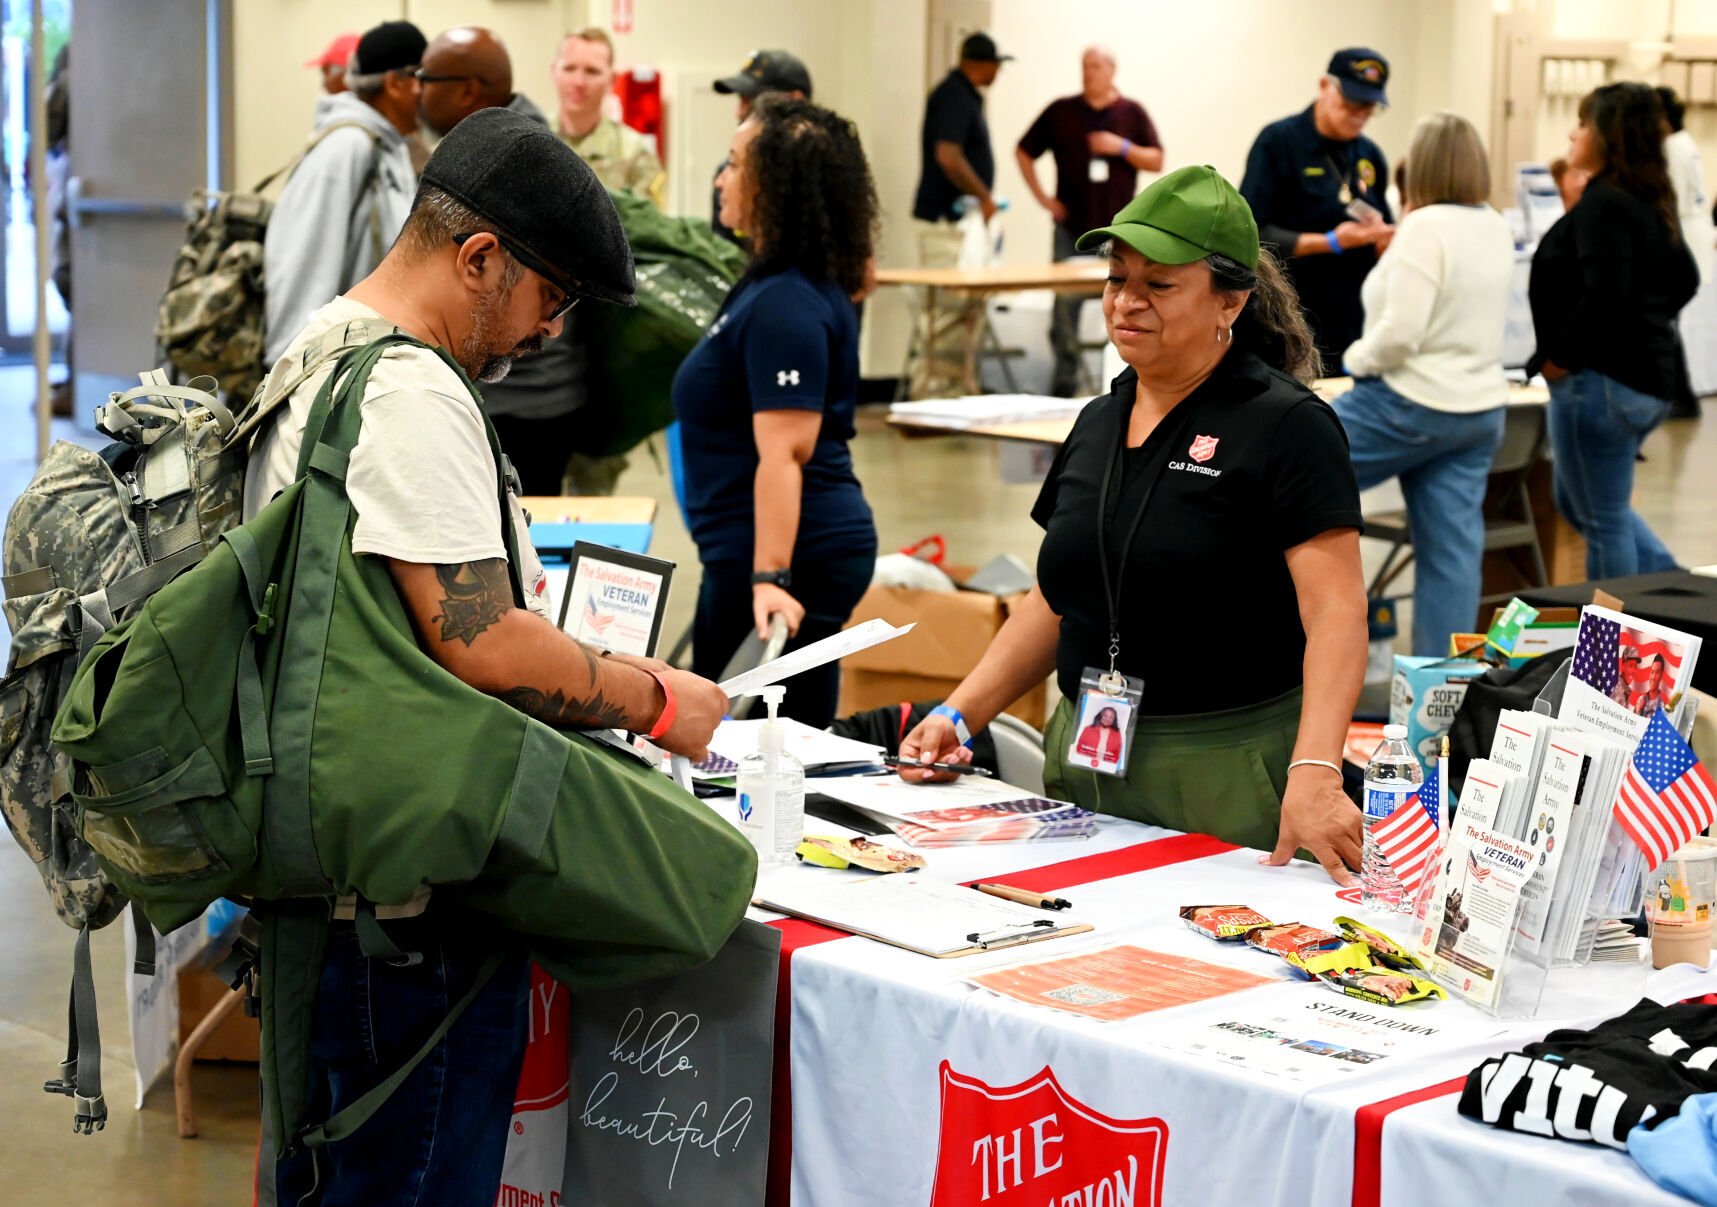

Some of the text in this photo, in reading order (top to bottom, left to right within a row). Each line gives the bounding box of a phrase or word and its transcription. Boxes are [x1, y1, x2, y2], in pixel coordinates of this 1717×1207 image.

[1168, 460, 1222, 477] CAS DIVISION
[581, 562, 657, 595] The Salvation Army
[603, 584, 649, 607] VETERAN
[1432, 690, 1462, 705] SOFT
[1591, 701, 1637, 727] The Salvation Army
[1504, 736, 1518, 751] The
[1492, 751, 1522, 773] Salvation
[1553, 756, 1566, 772] The
[1542, 773, 1569, 794] Salvation
[1472, 788, 1485, 803] The
[1542, 793, 1560, 813] Army
[1459, 803, 1488, 824] Salvation
[1466, 825, 1535, 864] The Salvation Army
[1483, 846, 1527, 870] VETERAN
[1305, 1002, 1376, 1021] STAND
[1373, 1018, 1440, 1036] DOWN
[609, 1007, 700, 1078] hello,
[579, 1071, 753, 1190] beautiful!
[970, 1112, 1065, 1202] THE
